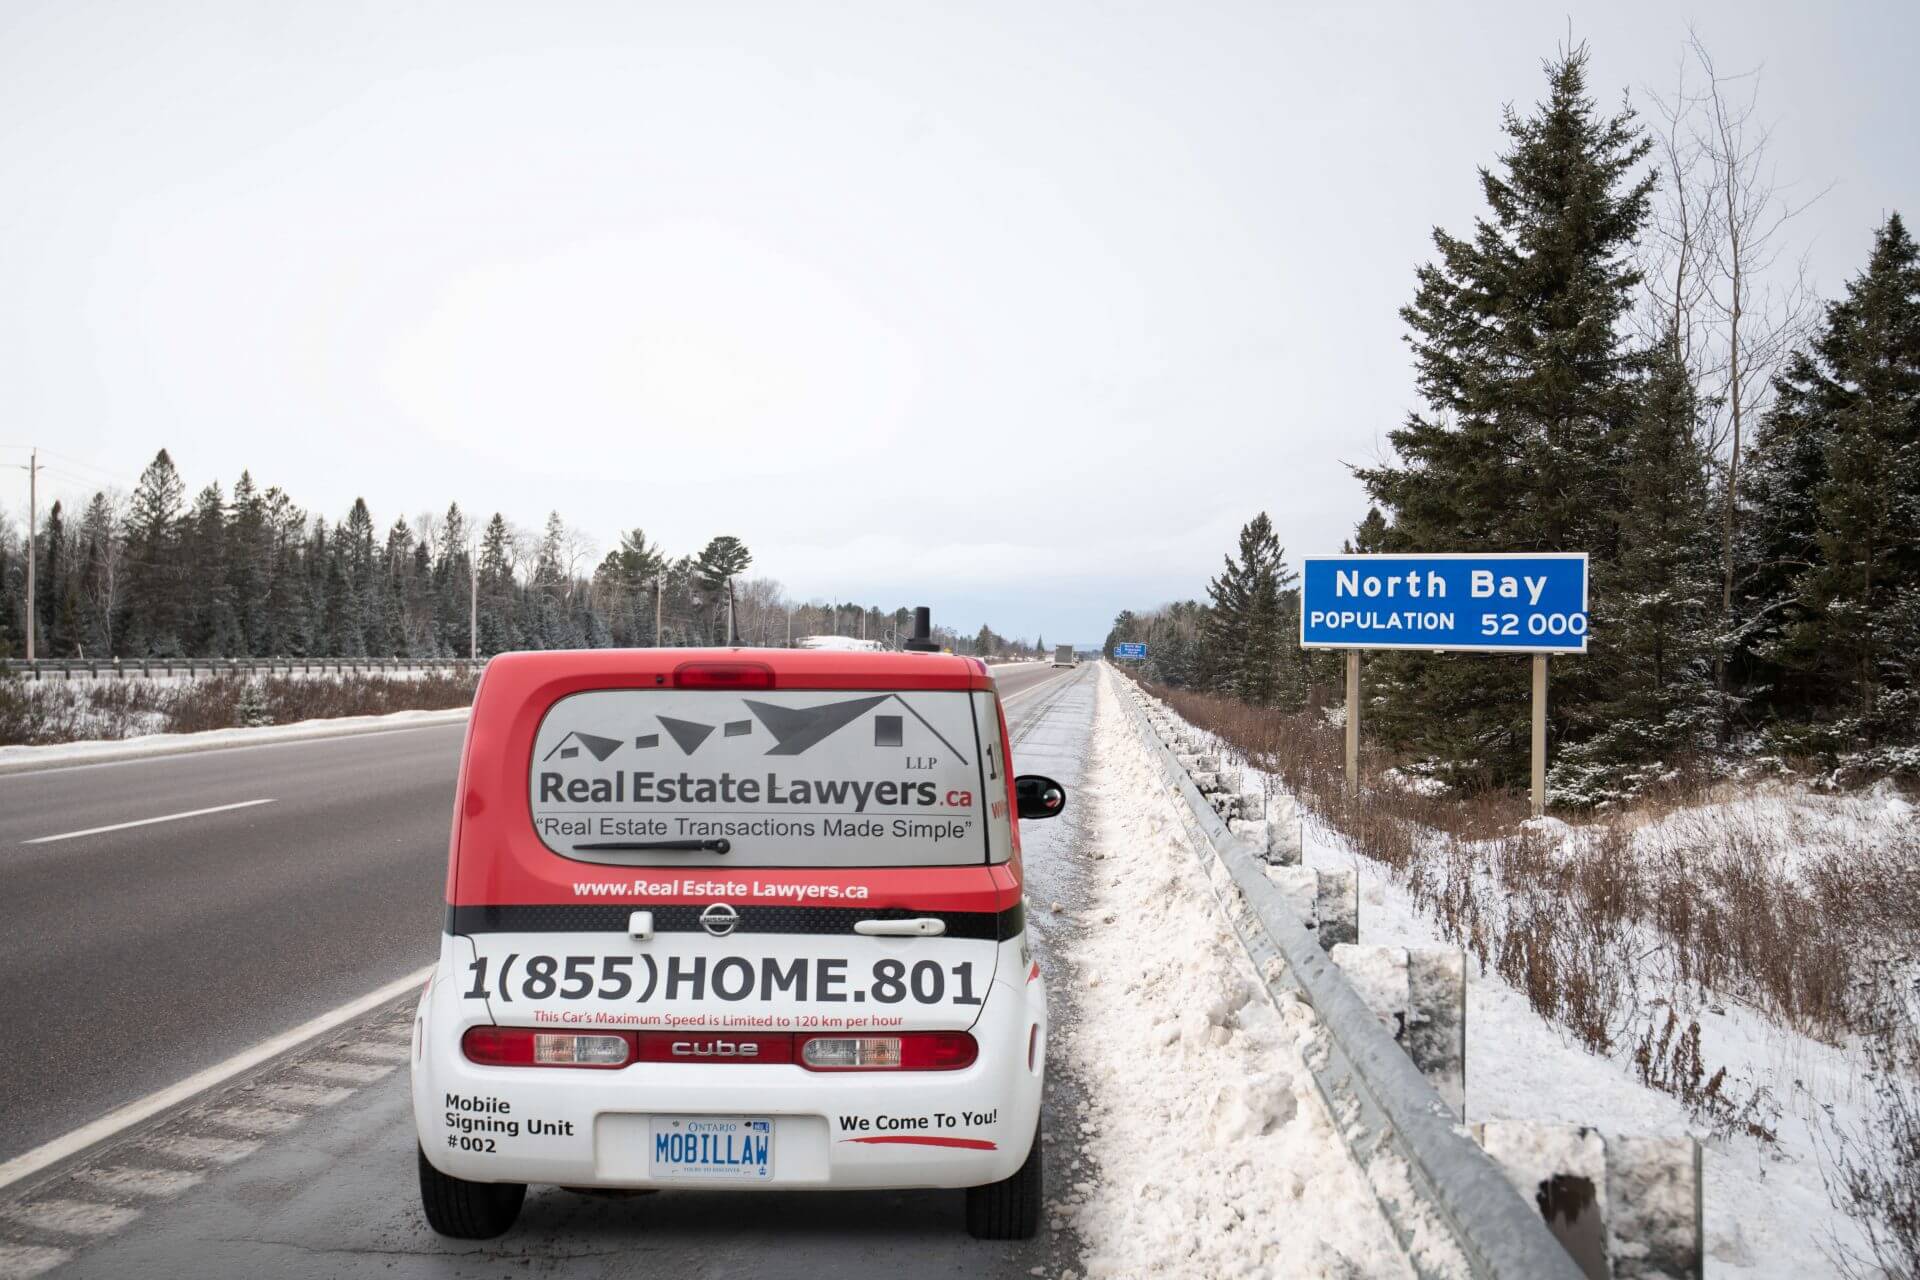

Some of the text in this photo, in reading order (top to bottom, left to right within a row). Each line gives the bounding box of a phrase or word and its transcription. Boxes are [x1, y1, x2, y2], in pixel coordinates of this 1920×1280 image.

[1335, 569, 1547, 606] North Bay
[1310, 611, 1455, 631] POPULATION
[906, 757, 937, 770] LLP
[600, 818, 668, 836] Estate
[674, 818, 815, 837] Transactions
[823, 819, 884, 838] Made
[463, 953, 982, 1006] 1(855)HOME.801
[534, 1010, 559, 1023] This
[595, 1012, 661, 1025] Maximum
[664, 1013, 705, 1026] Speed
[709, 1014, 720, 1026] is
[723, 1015, 773, 1027] Limited
[777, 1015, 790, 1027] to
[795, 1016, 818, 1027] 120
[822, 1015, 842, 1027] km
[846, 1016, 868, 1029] per
[872, 1014, 903, 1026] hour
[671, 1039, 759, 1057] cube
[446, 1112, 574, 1137] Signing Unit
[839, 1108, 997, 1131] We Come To You!
[447, 1134, 497, 1153] #002
[655, 1132, 768, 1165] MOBILLAW
